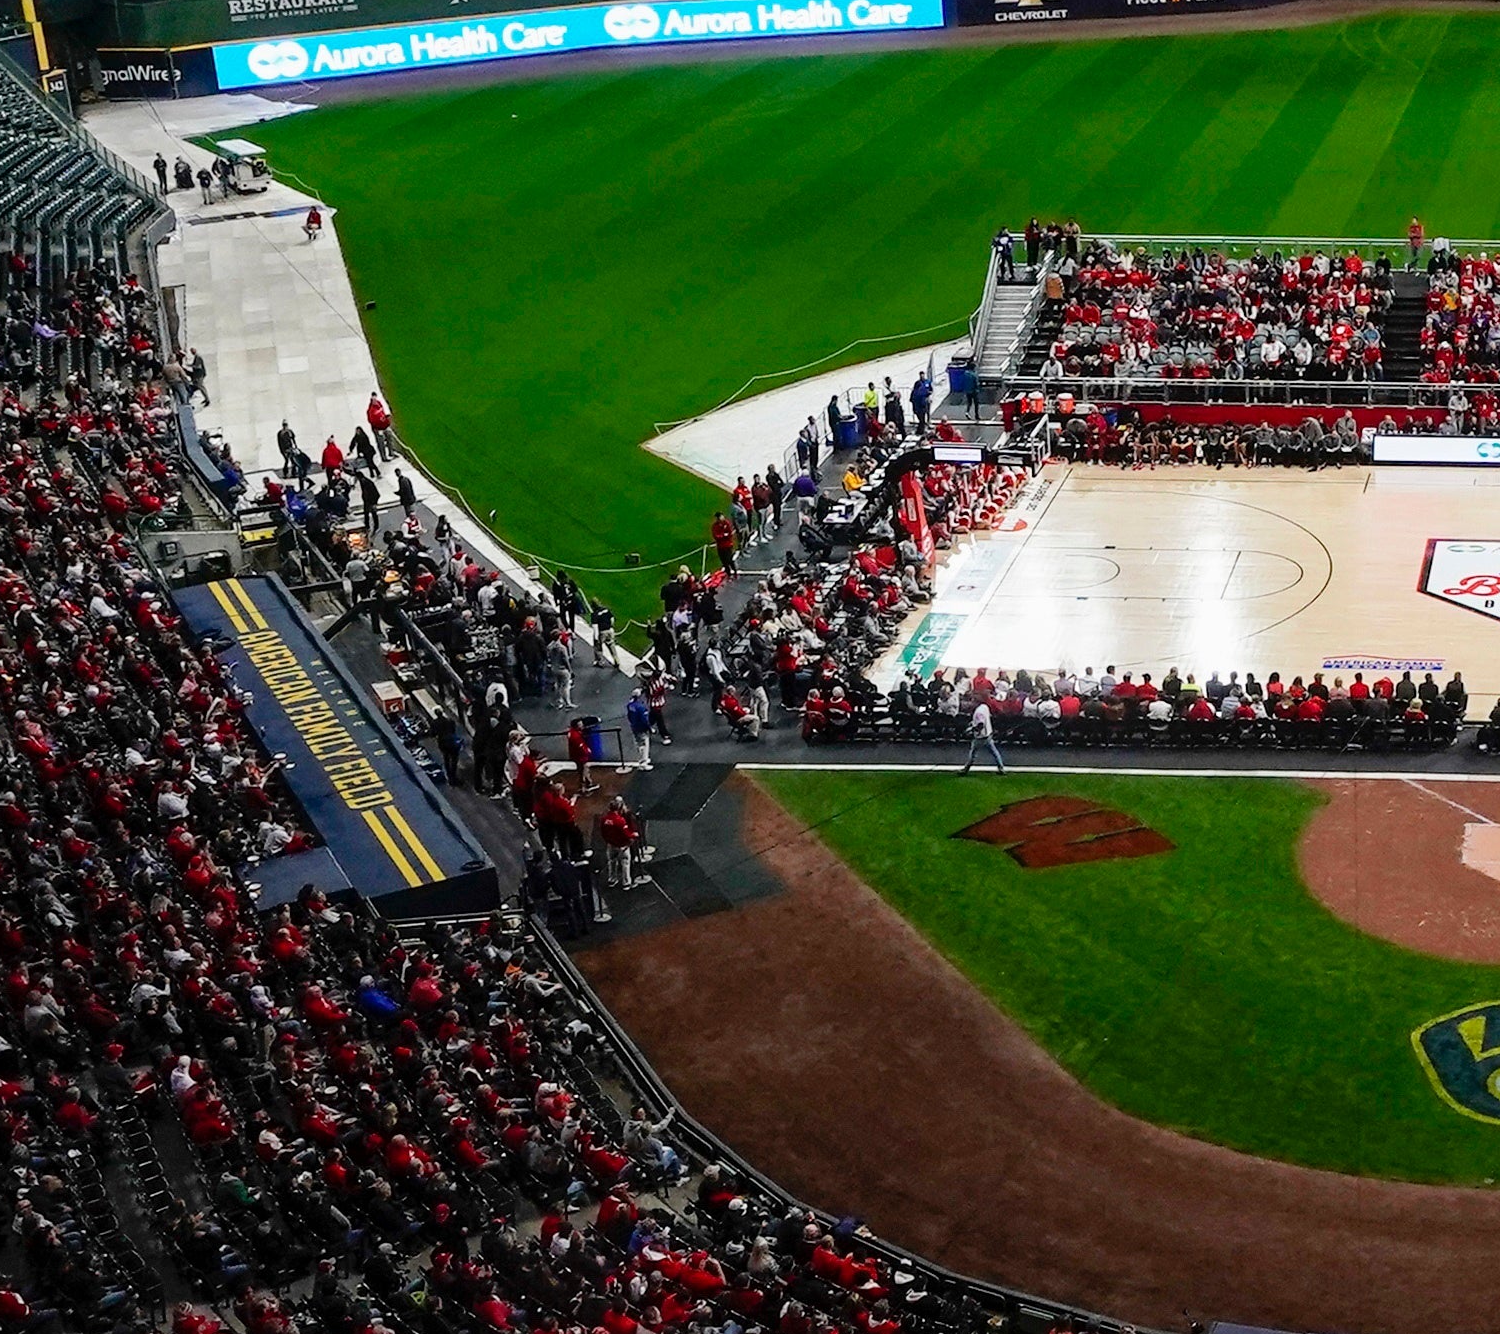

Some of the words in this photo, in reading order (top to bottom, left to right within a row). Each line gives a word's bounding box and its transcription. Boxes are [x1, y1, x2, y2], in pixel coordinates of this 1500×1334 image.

[663, 8, 753, 36] Aurora
[757, 0, 842, 29] Health
[847, 0, 912, 25] Care
[995, 9, 1068, 22] CHEVROLET
[314, 40, 405, 74] Aurora
[410, 24, 498, 60] Health
[502, 23, 568, 50] Care
[237, 630, 322, 707] AMERICAN
[285, 699, 363, 761] FAMILY
[324, 756, 394, 810] FIELD
